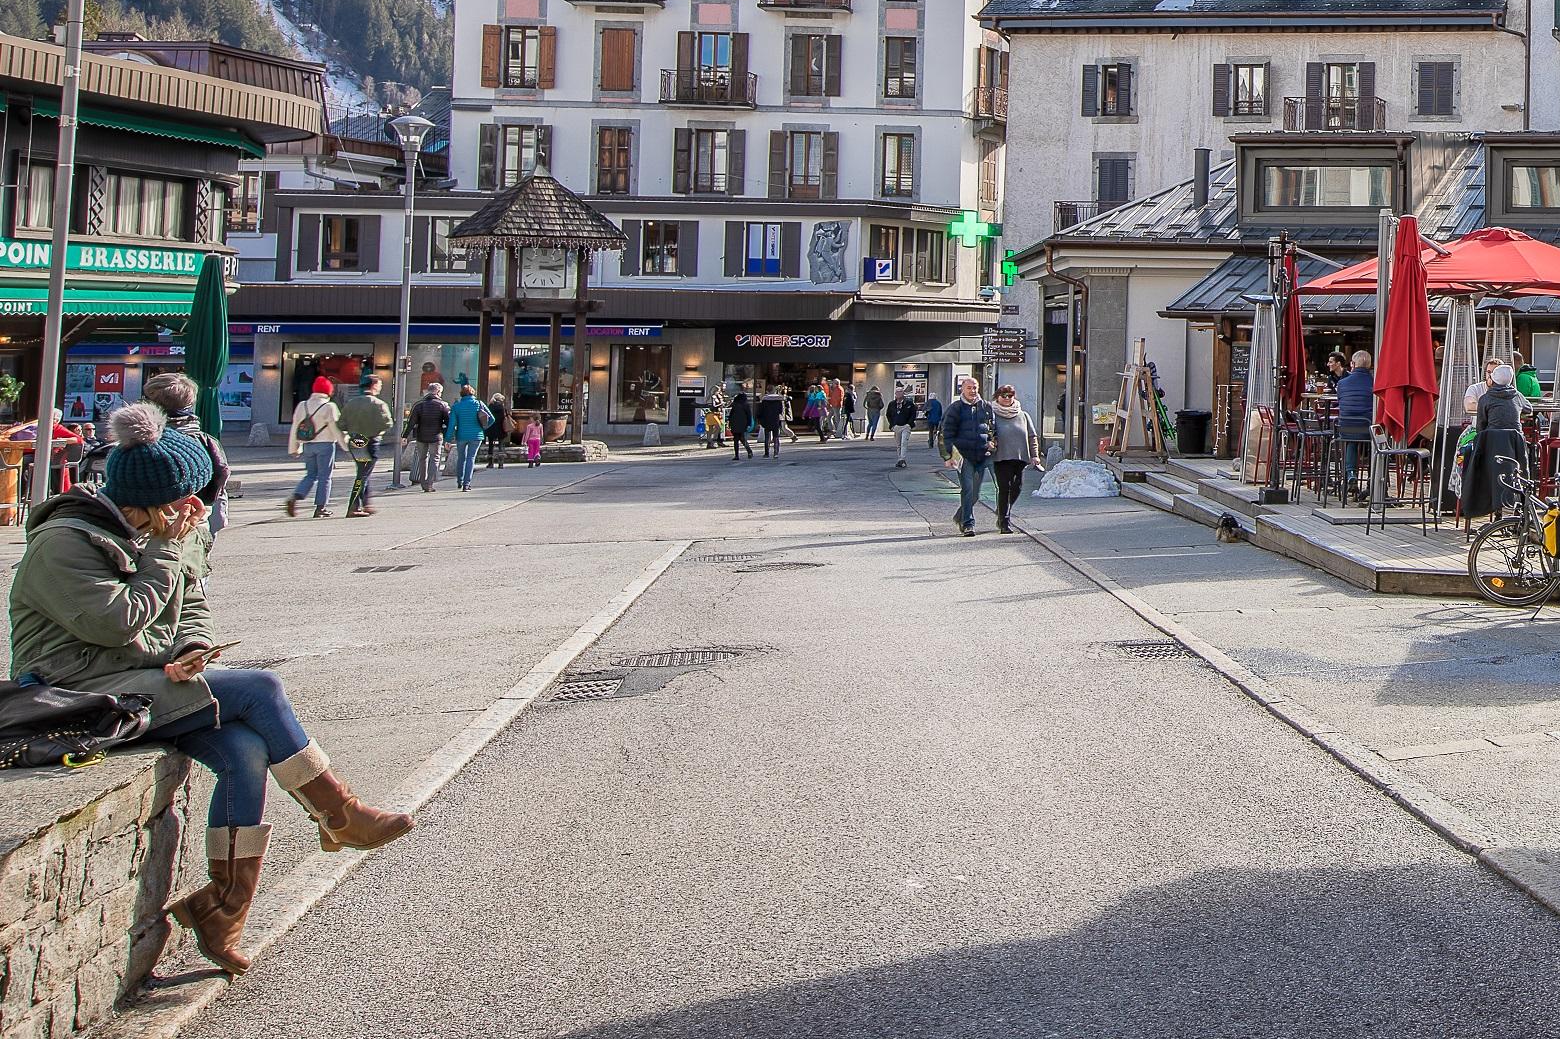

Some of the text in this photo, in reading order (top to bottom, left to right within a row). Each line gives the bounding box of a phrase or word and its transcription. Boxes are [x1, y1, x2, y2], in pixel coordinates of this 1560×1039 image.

[79, 245, 196, 272] BRASSERIE
[257, 325, 281, 333] RENT
[628, 327, 651, 336] RENT
[750, 334, 832, 348] INTERSPORT
